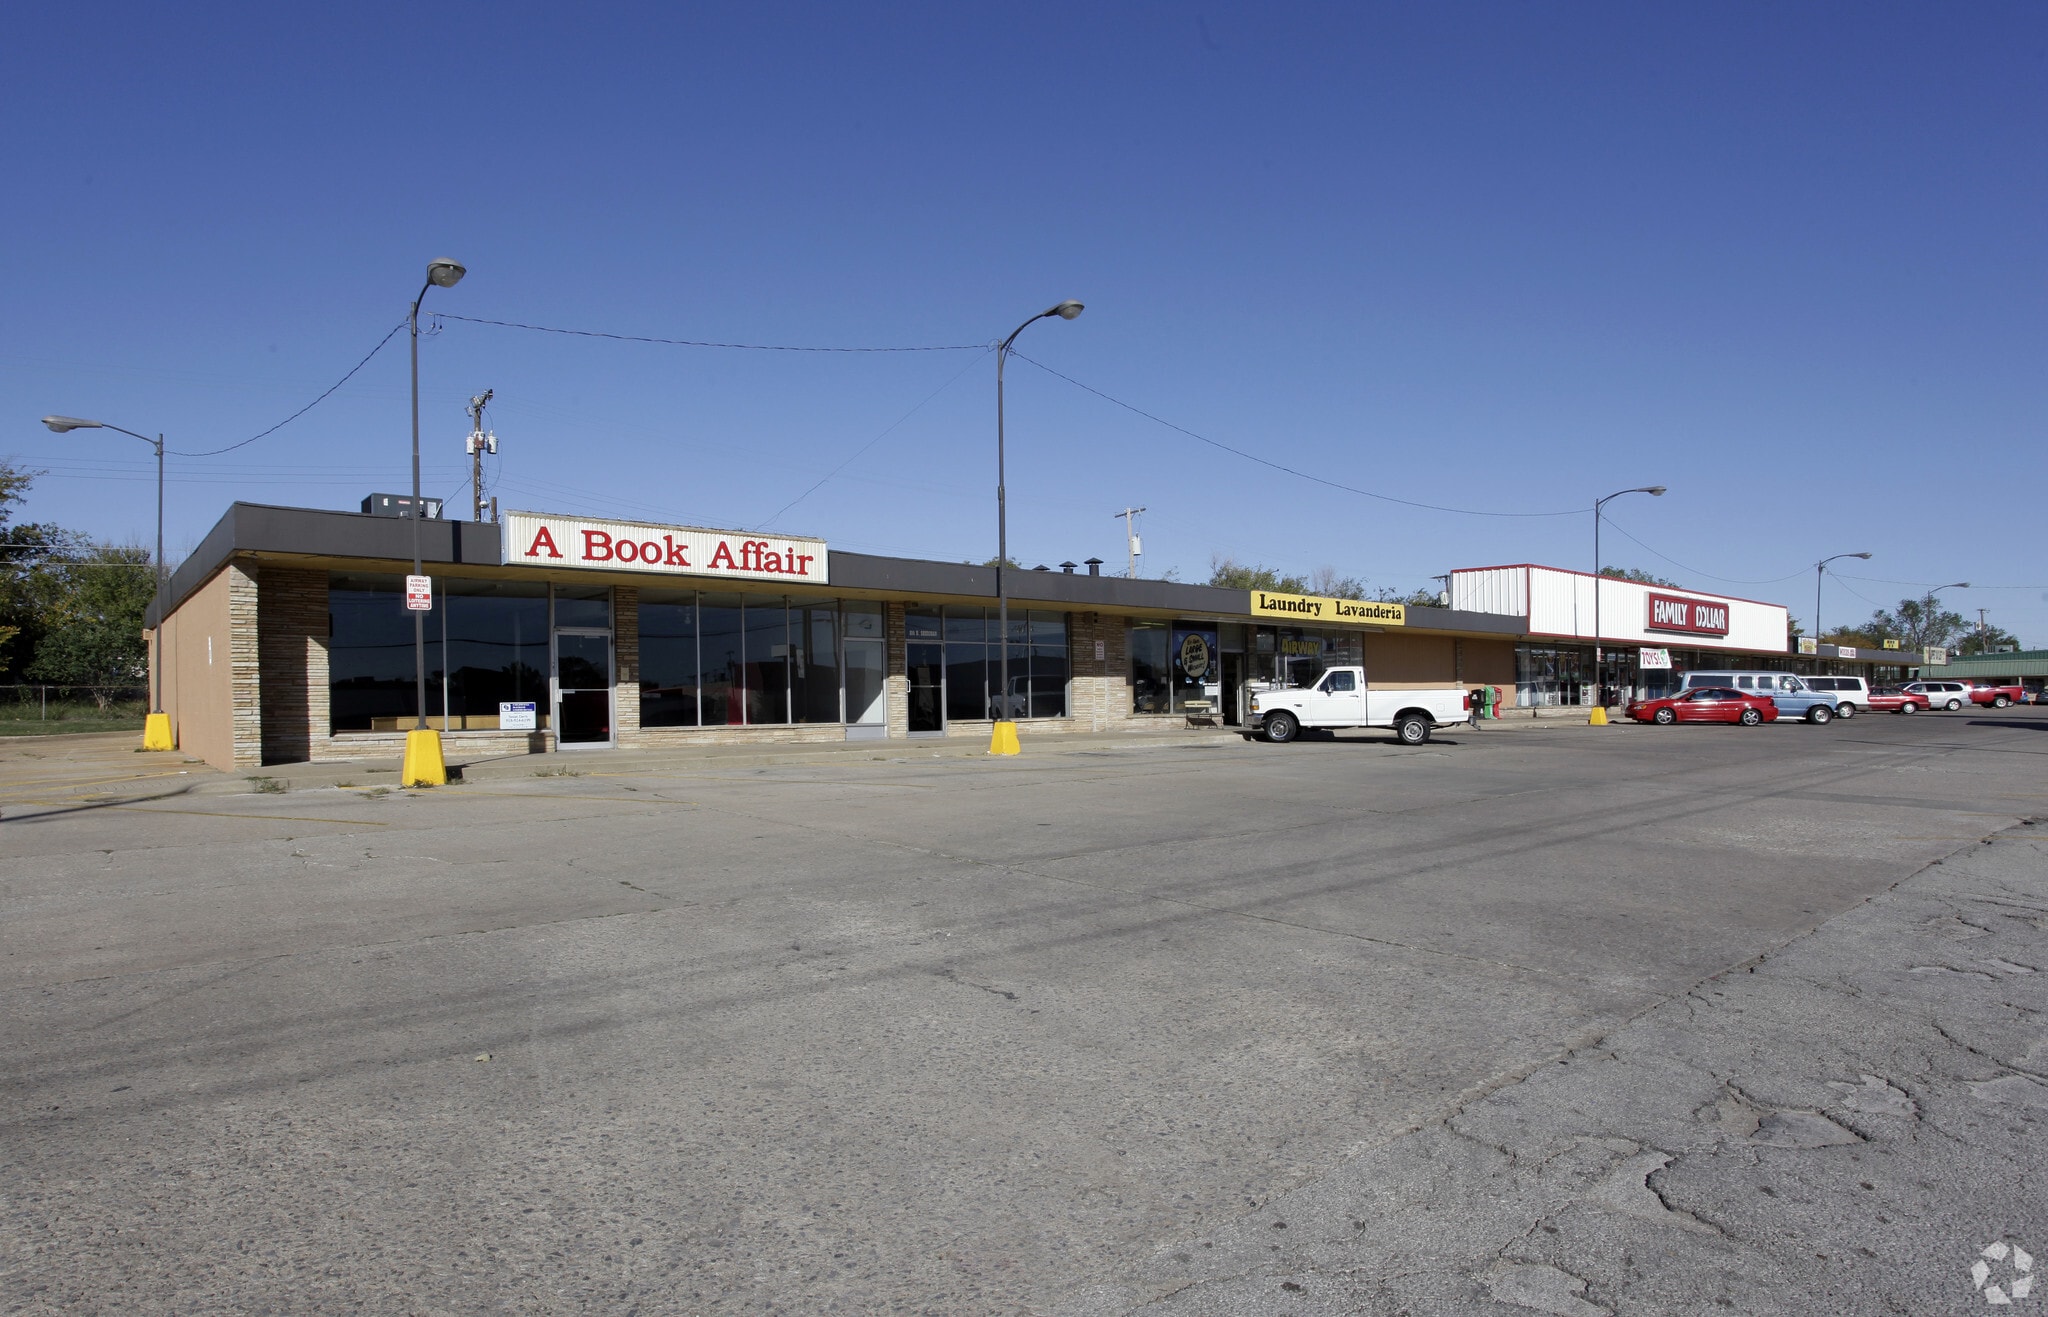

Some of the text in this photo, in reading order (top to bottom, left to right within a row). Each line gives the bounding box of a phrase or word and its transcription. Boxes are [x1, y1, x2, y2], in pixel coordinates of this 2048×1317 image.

[524, 526, 814, 576] A Book Affair
[1259, 593, 1402, 620] Laundry Lavanderia
[1654, 599, 1726, 630] FAMILY DOLLAR
[1186, 643, 1203, 655] LARGE
[1281, 638, 1321, 655] AIRWAY
[1189, 653, 1204, 663] SMALL
[1641, 651, 1662, 665] TOYS!
